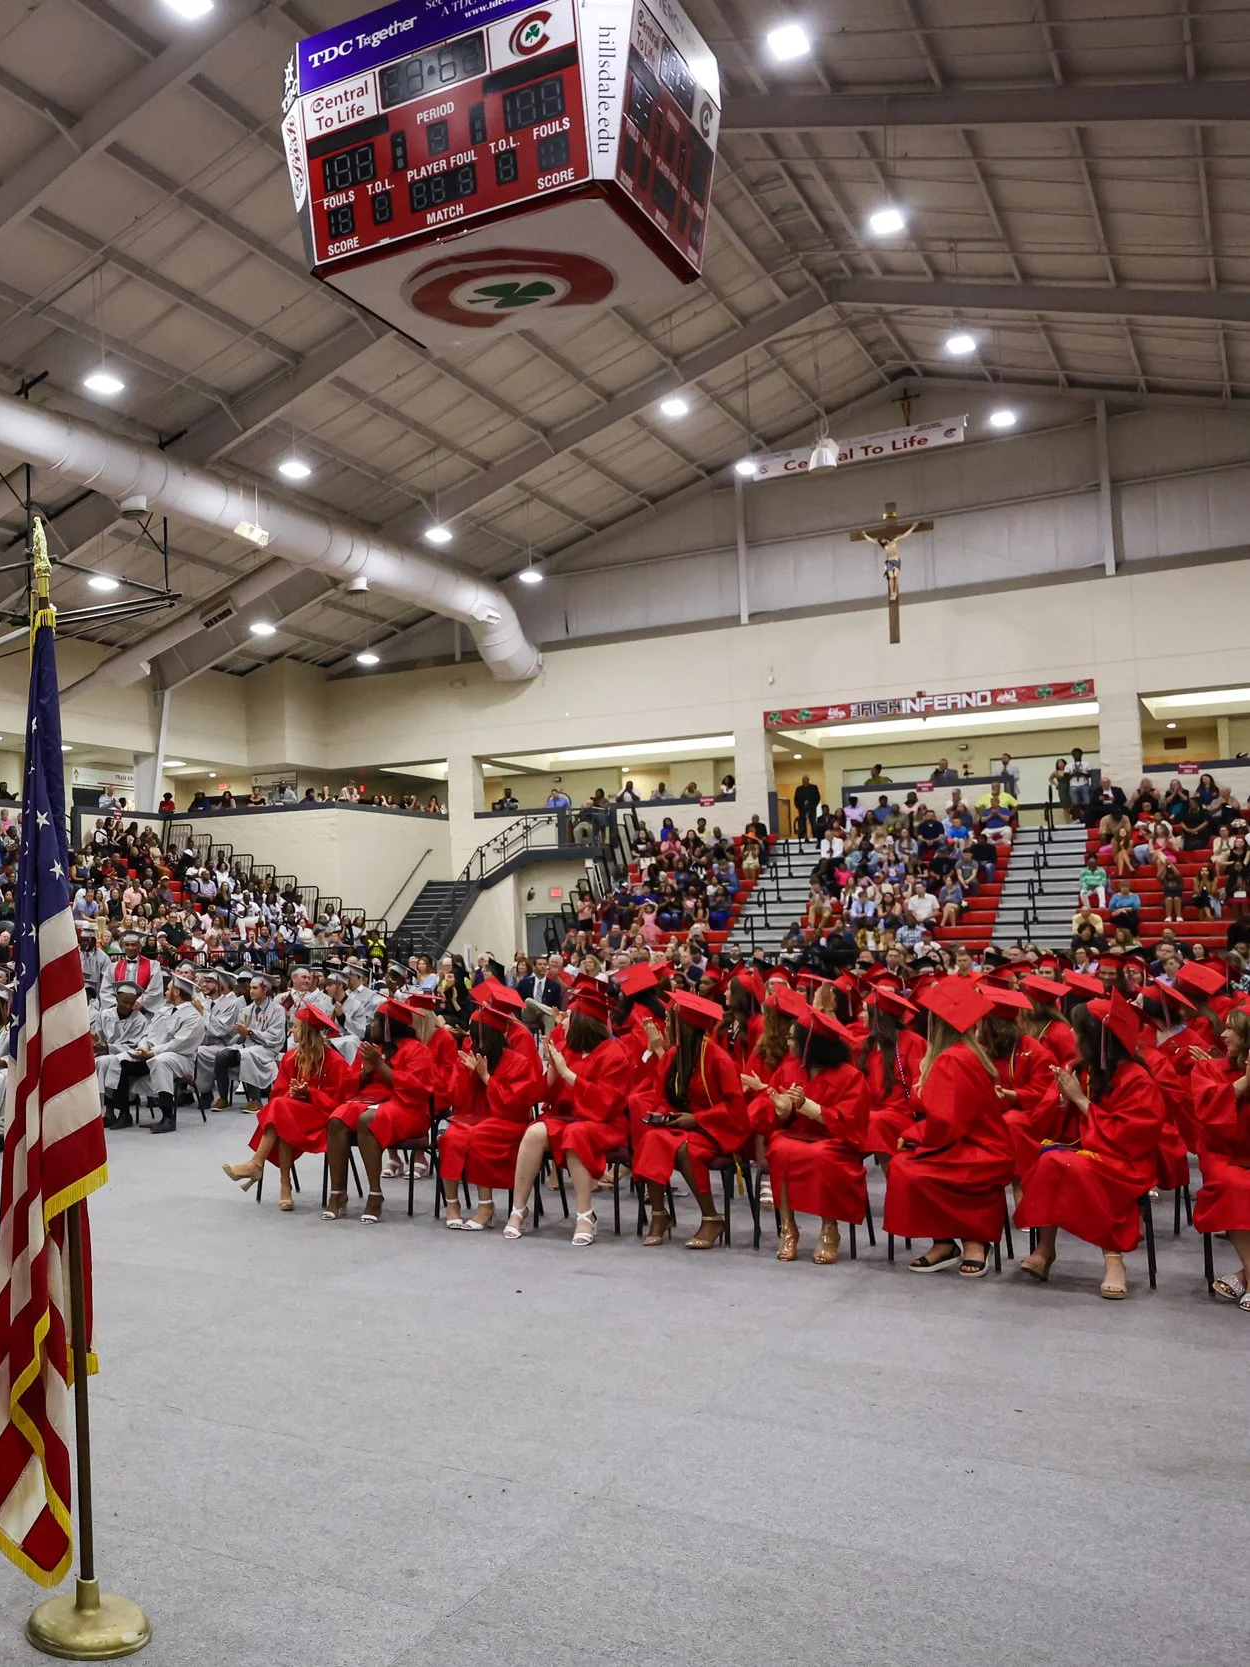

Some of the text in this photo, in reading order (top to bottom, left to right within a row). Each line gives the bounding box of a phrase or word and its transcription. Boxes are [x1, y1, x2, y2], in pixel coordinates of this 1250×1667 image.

[308, 39, 353, 68] TDC
[311, 80, 369, 113] Central
[597, 26, 616, 154] hillsdale.edu
[315, 105, 365, 131] To Life
[416, 101, 455, 125] PERIOD
[532, 116, 571, 140] FOULS
[488, 136, 521, 154] T.O.L.
[407, 149, 478, 182] PLAYER FOUL
[366, 178, 395, 196] T.O.L.
[537, 167, 575, 190] SCORE
[323, 190, 355, 210] FOULS
[426, 203, 464, 225] MATCH
[327, 236, 360, 256] SCORE
[784, 449, 854, 472] Ceal
[861, 444, 884, 458] To
[891, 435, 928, 451] Life
[900, 690, 992, 714] INFERNO
